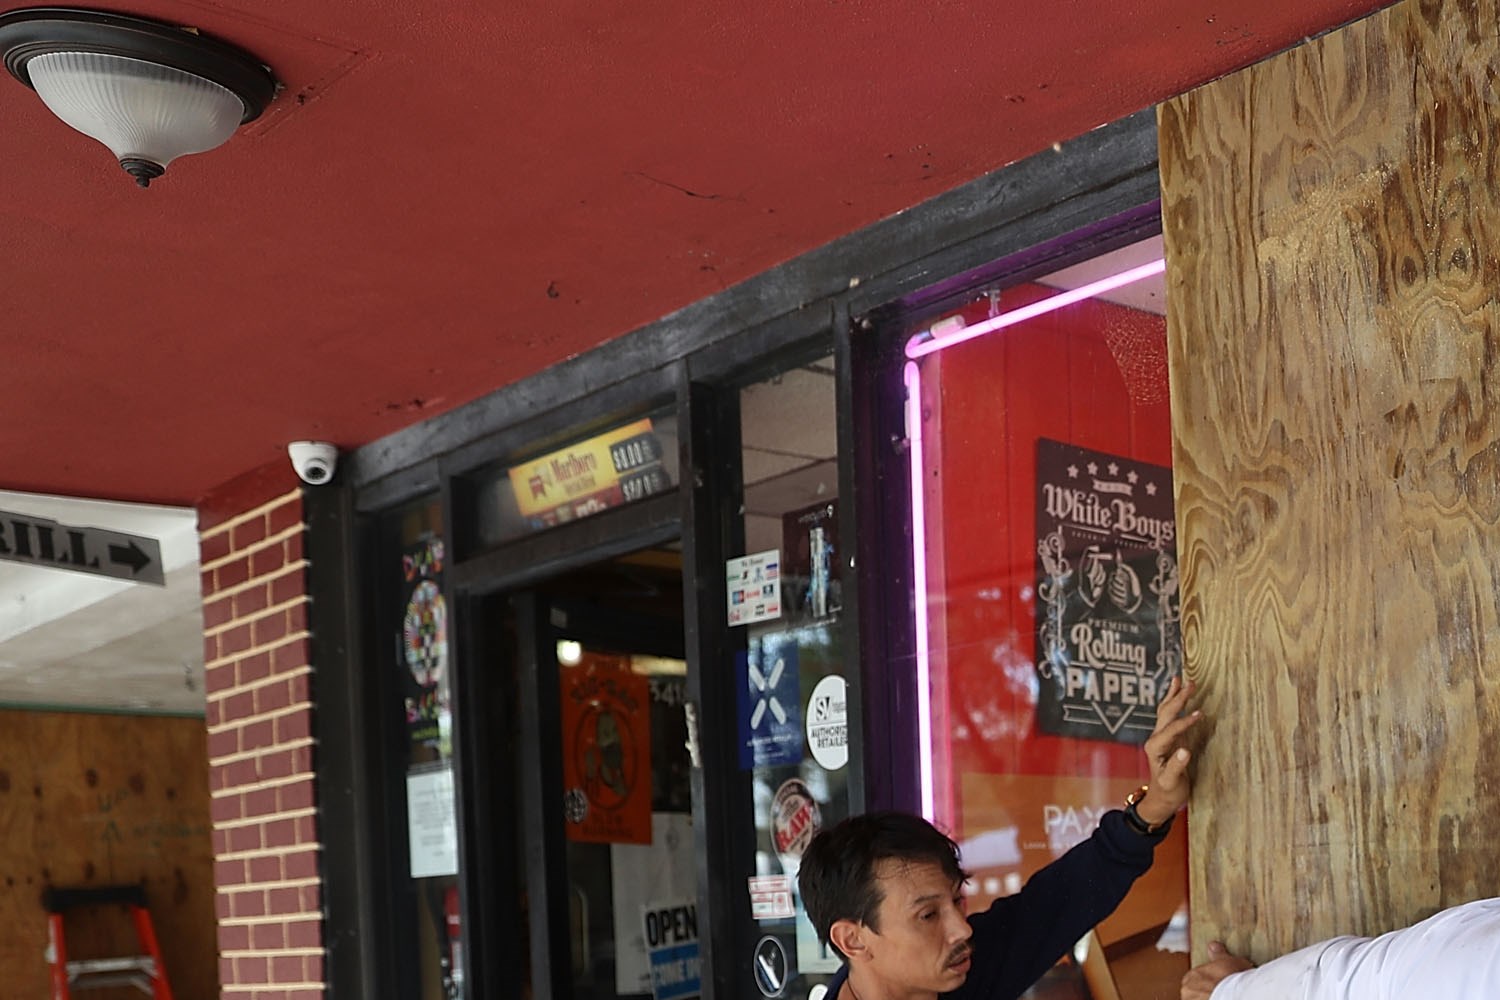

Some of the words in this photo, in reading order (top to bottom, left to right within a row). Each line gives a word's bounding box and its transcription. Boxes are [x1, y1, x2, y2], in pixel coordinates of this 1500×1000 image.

[550, 451, 598, 483] Marlboro
[1042, 483, 1112, 528] White
[1111, 498, 1175, 550] Boys
[1088, 618, 1139, 634] PREMIUM
[1070, 623, 1147, 677] Rolling
[1066, 666, 1156, 706] PAPER
[774, 800, 814, 854] RAW
[645, 904, 699, 948] OPEN
